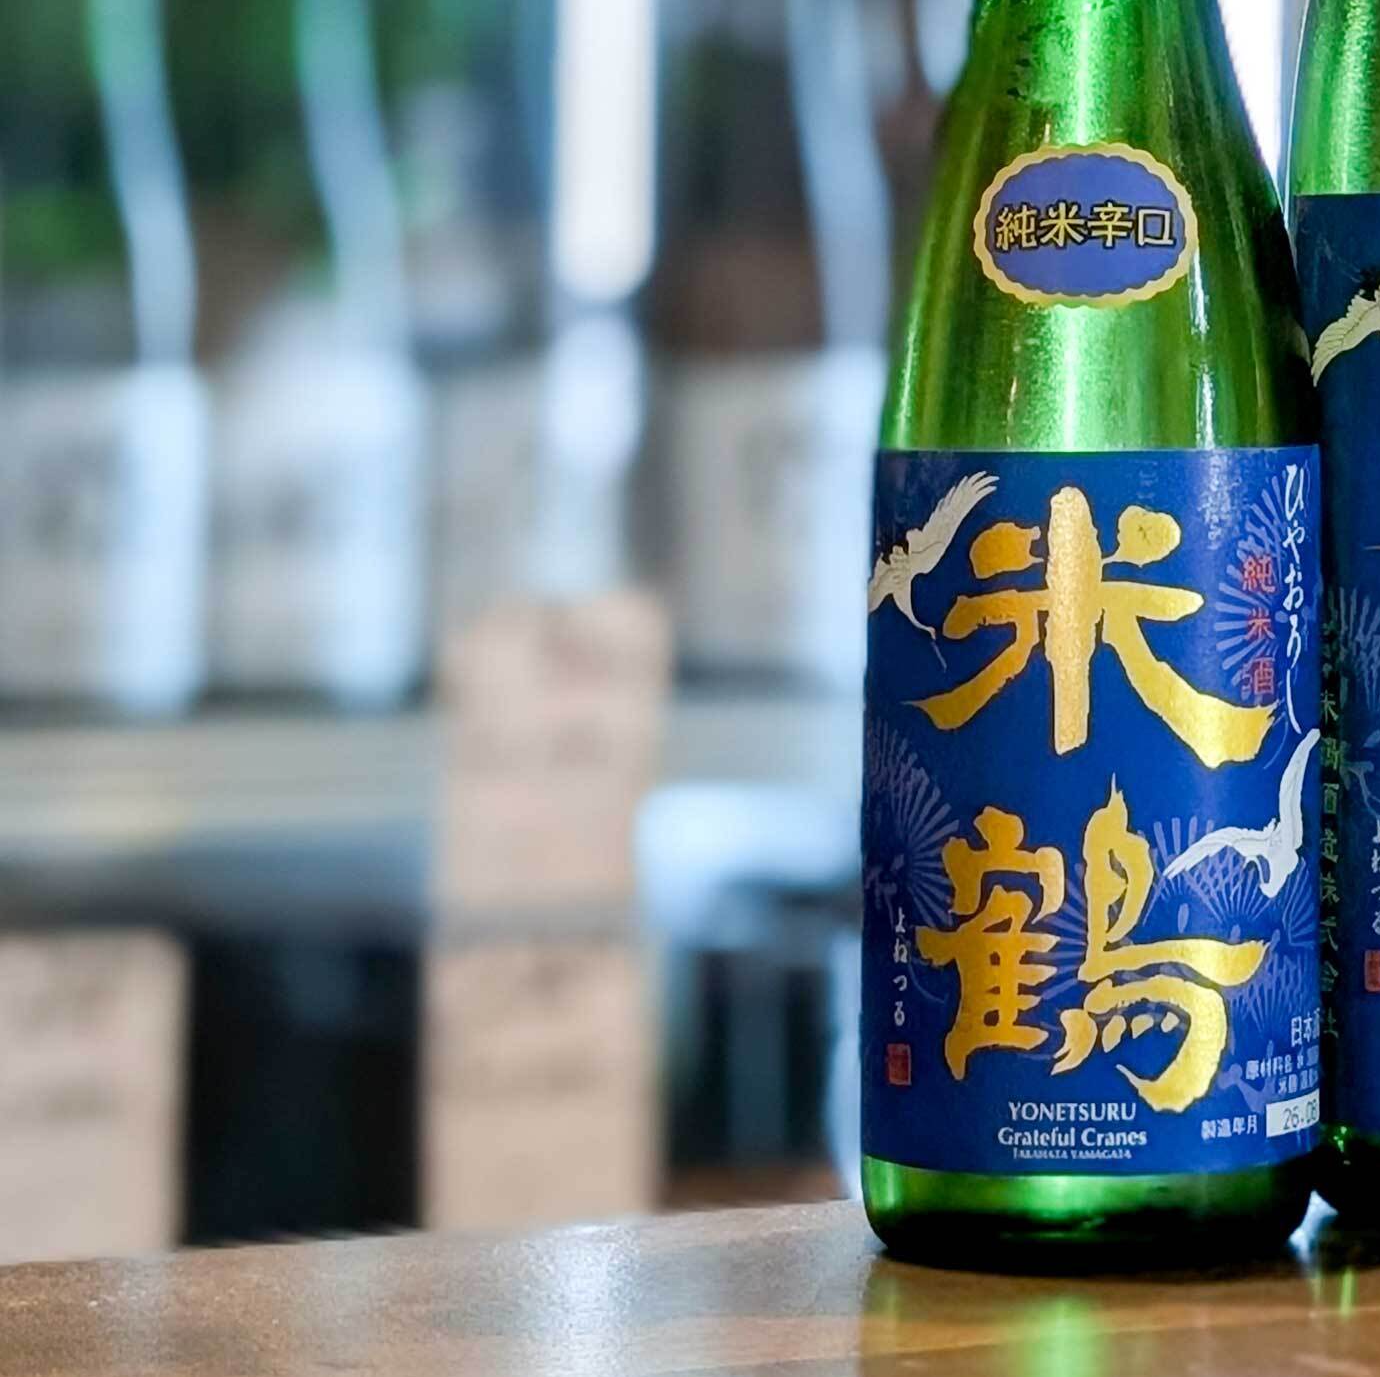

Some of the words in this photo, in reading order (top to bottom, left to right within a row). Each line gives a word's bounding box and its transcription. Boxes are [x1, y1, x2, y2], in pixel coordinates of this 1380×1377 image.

[995, 202, 1174, 251] 純米辛口
[1242, 554, 1276, 698] 純米酒
[1283, 464, 1305, 735] ひやおろし
[902, 485, 1278, 1113] 米鶴
[893, 907, 908, 1026] よねつる
[998, 1127, 1076, 1147] Grateful
[1081, 1127, 1148, 1147] Cranes
[1008, 1101, 1137, 1122] YONETSURU
